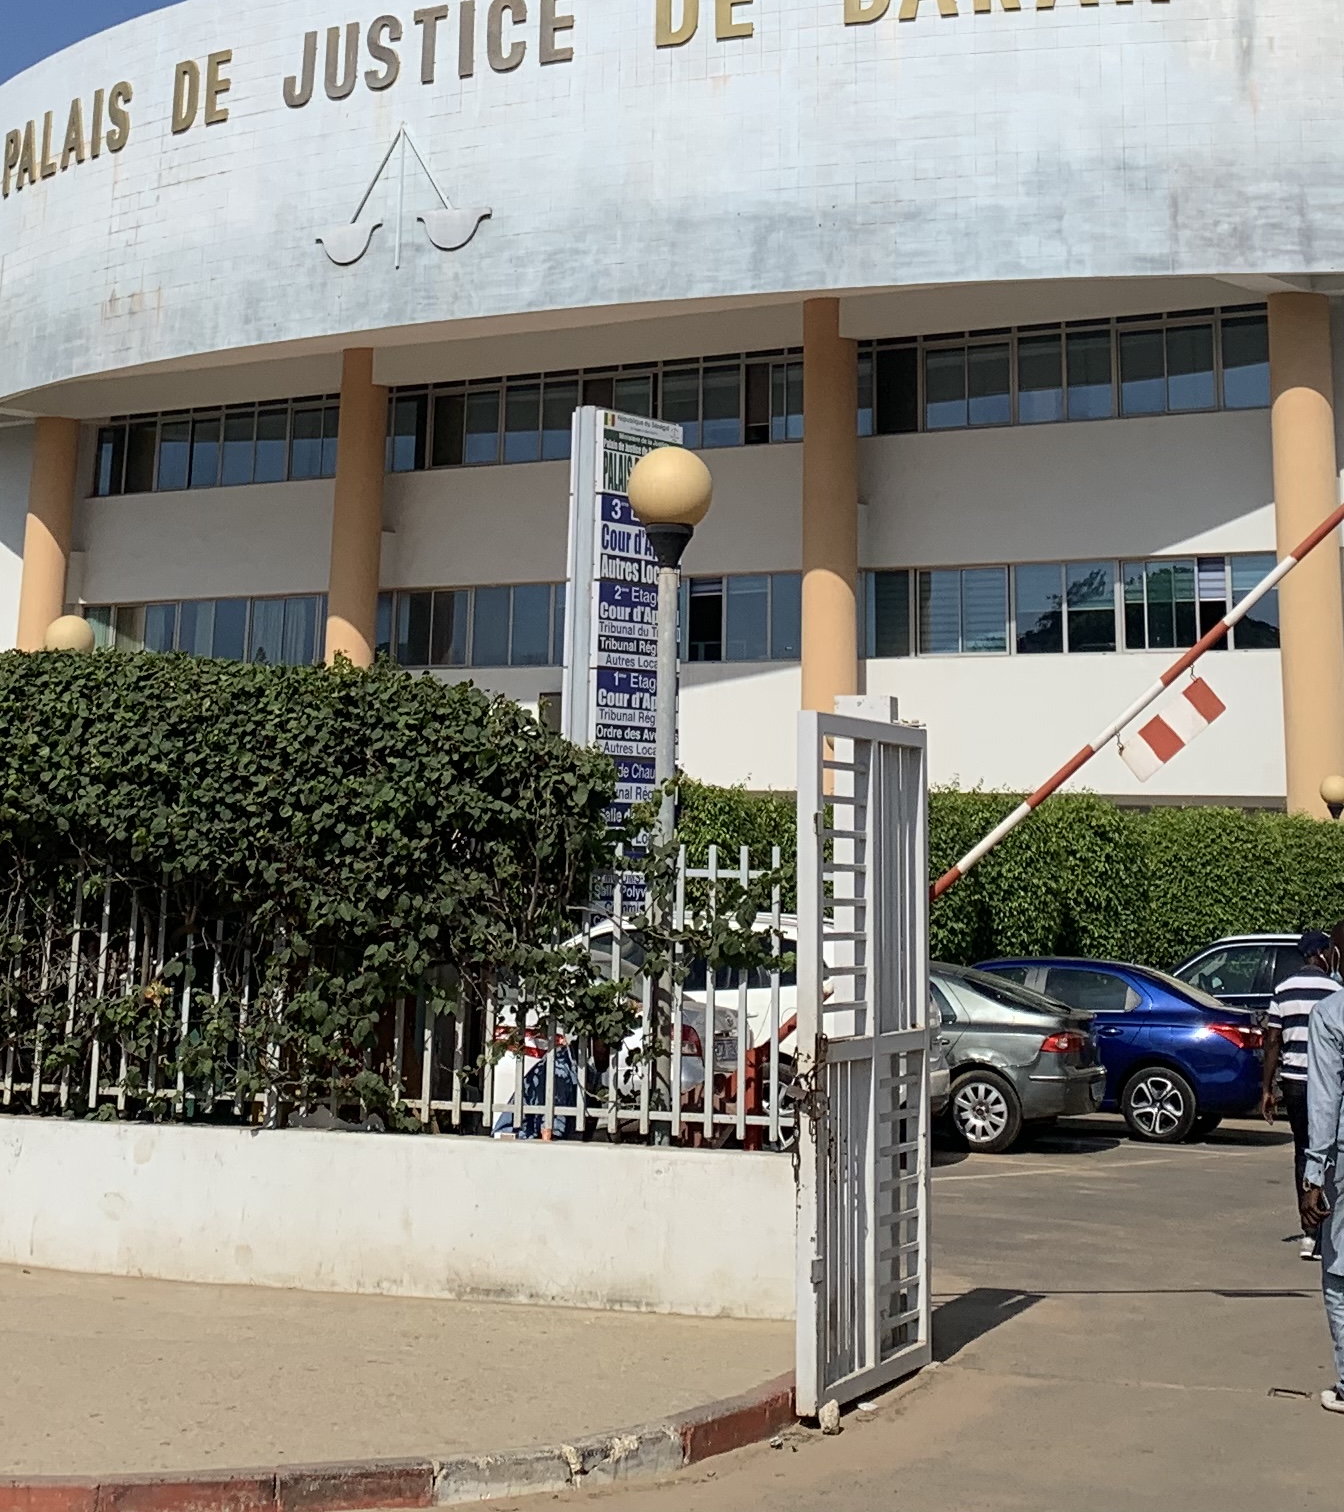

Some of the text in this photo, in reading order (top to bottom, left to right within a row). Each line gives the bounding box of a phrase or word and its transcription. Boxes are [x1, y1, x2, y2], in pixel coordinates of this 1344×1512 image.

[1, 80, 133, 198] PALAIS
[171, 48, 232, 134] DE
[601, 523, 631, 553] Cour
[601, 554, 639, 582] Autres
[631, 587, 658, 607] Etag
[600, 601, 658, 625] Cour d'Ap
[599, 621, 635, 635] Tribunal
[637, 626, 649, 637] du
[599, 636, 657, 656] Tribunal Rég
[605, 654, 635, 668] Autres
[630, 673, 657, 693] Etag
[598, 688, 657, 711] Cour d'Ap
[599, 708, 656, 727] Tribunal Rég
[596, 725, 622, 739] Ordre
[624, 727, 641, 740] des
[604, 741, 633, 754] Autres
[631, 763, 655, 779] Chau
